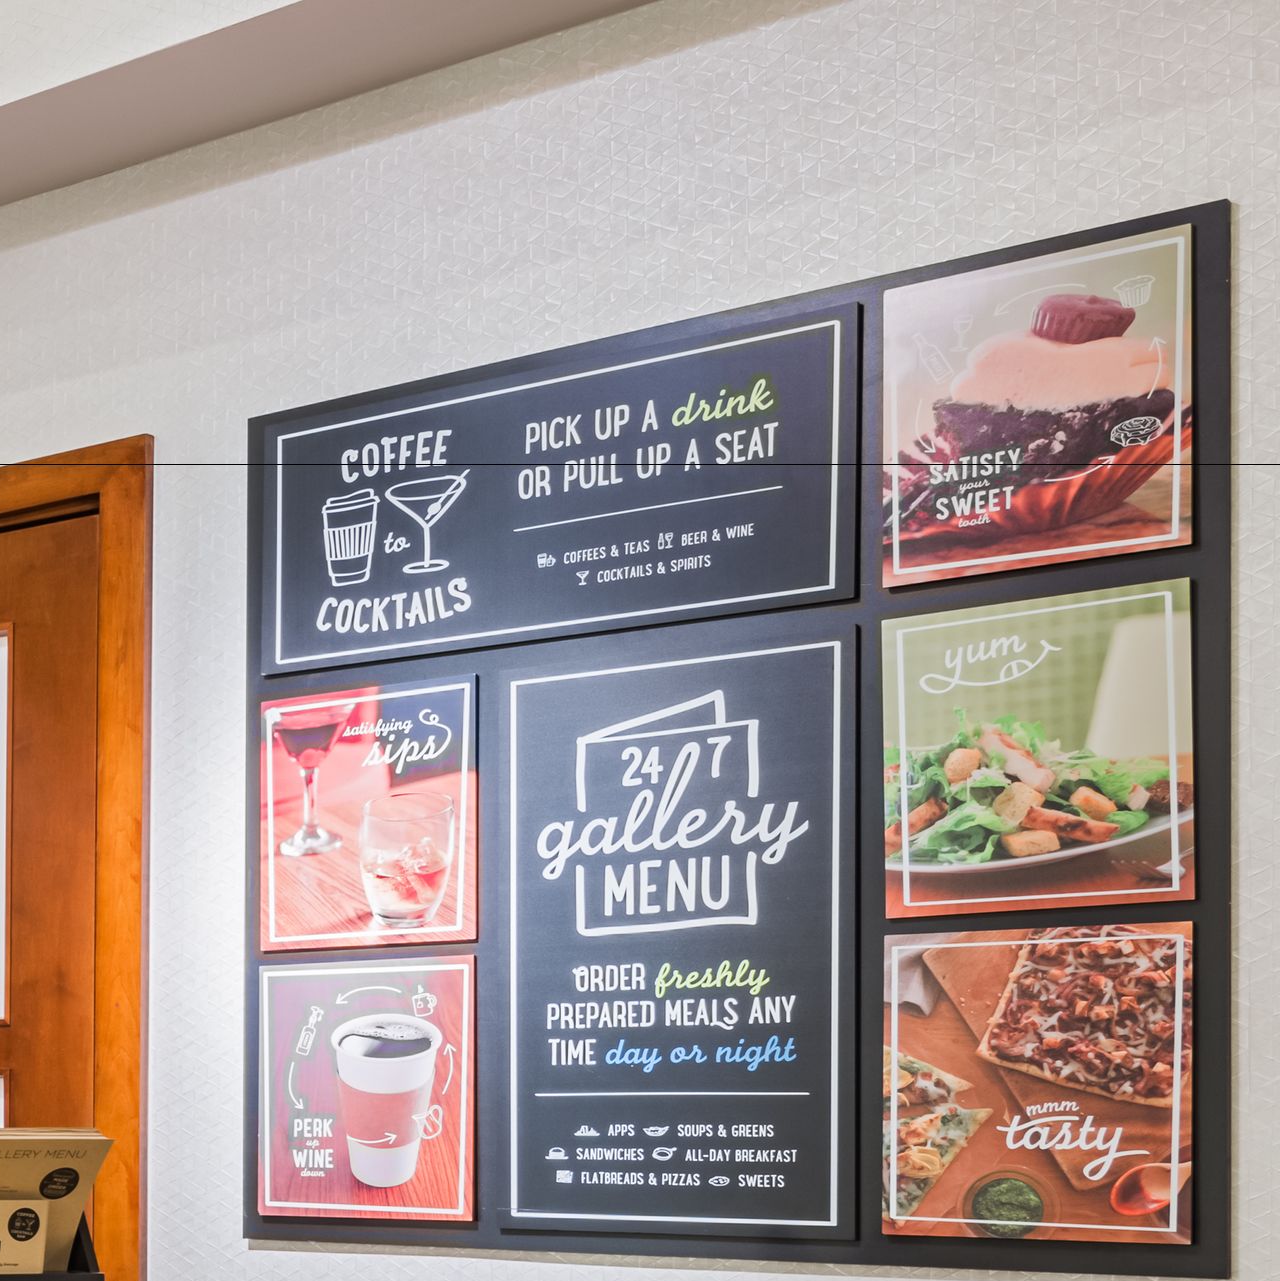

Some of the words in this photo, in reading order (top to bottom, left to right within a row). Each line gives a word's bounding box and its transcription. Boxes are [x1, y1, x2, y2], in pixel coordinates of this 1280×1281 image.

[525, 414, 582, 454] PICK
[594, 404, 630, 440] UP
[641, 399, 658, 432] A
[671, 378, 774, 427] drink
[341, 430, 452, 483] COFFEE
[517, 464, 551, 499] OR
[563, 453, 623, 492] PULL
[636, 442, 671, 479] UP
[684, 438, 701, 471] A
[715, 421, 779, 465] SEAT
[929, 448, 1021, 485] SATISFY
[959, 479, 990, 494] your
[935, 486, 1015, 520] SWEET
[958, 514, 991, 528] tooth
[383, 532, 410, 553] to
[681, 531, 707, 547] BEER
[711, 528, 721, 541] &
[725, 523, 755, 539] WINE
[563, 546, 606, 564] COFFEES
[610, 545, 619, 557] &
[624, 540, 650, 555] TEAS
[597, 563, 652, 583] COCKTAILS
[657, 561, 666, 574] &
[670, 555, 711, 573] SPIRITS
[316, 577, 472, 633] COCKTAILS
[920, 635, 1030, 694] yum
[342, 718, 413, 737] satisfying
[362, 728, 446, 774] sips
[621, 746, 663, 786] 24
[707, 735, 731, 778] 7
[537, 742, 809, 881] gallery
[604, 855, 730, 916] MENU
[572, 963, 646, 992] ORDER
[655, 959, 770, 998] freshly
[546, 1000, 656, 1029] PREPARED
[665, 998, 739, 1030] MEALS
[748, 995, 796, 1024] ANY
[548, 1038, 597, 1066] TIME
[605, 1039, 662, 1073] day
[670, 1044, 707, 1063] or
[715, 1035, 798, 1071] night
[1026, 1100, 1080, 1116] mmm
[293, 1119, 333, 1137] PERK
[607, 1124, 635, 1137] APPS
[677, 1125, 714, 1137] SOUPS
[717, 1124, 727, 1137] &
[731, 1124, 775, 1137] GREENS
[44, 1150, 87, 1159] MENU
[306, 1139, 320, 1148] up
[576, 1148, 645, 1161] SANDWICHES
[996, 1115, 1150, 1181] tasty
[292, 1149, 334, 1168] WINE
[685, 1149, 730, 1162] ALL-DAY
[735, 1149, 797, 1163] BREAKFAST
[300, 1168, 325, 1177] down
[580, 1171, 644, 1185] FLATBREADS
[648, 1172, 658, 1185] &
[661, 1173, 701, 1186] PIZZAS
[738, 1175, 785, 1187] SWEETS
